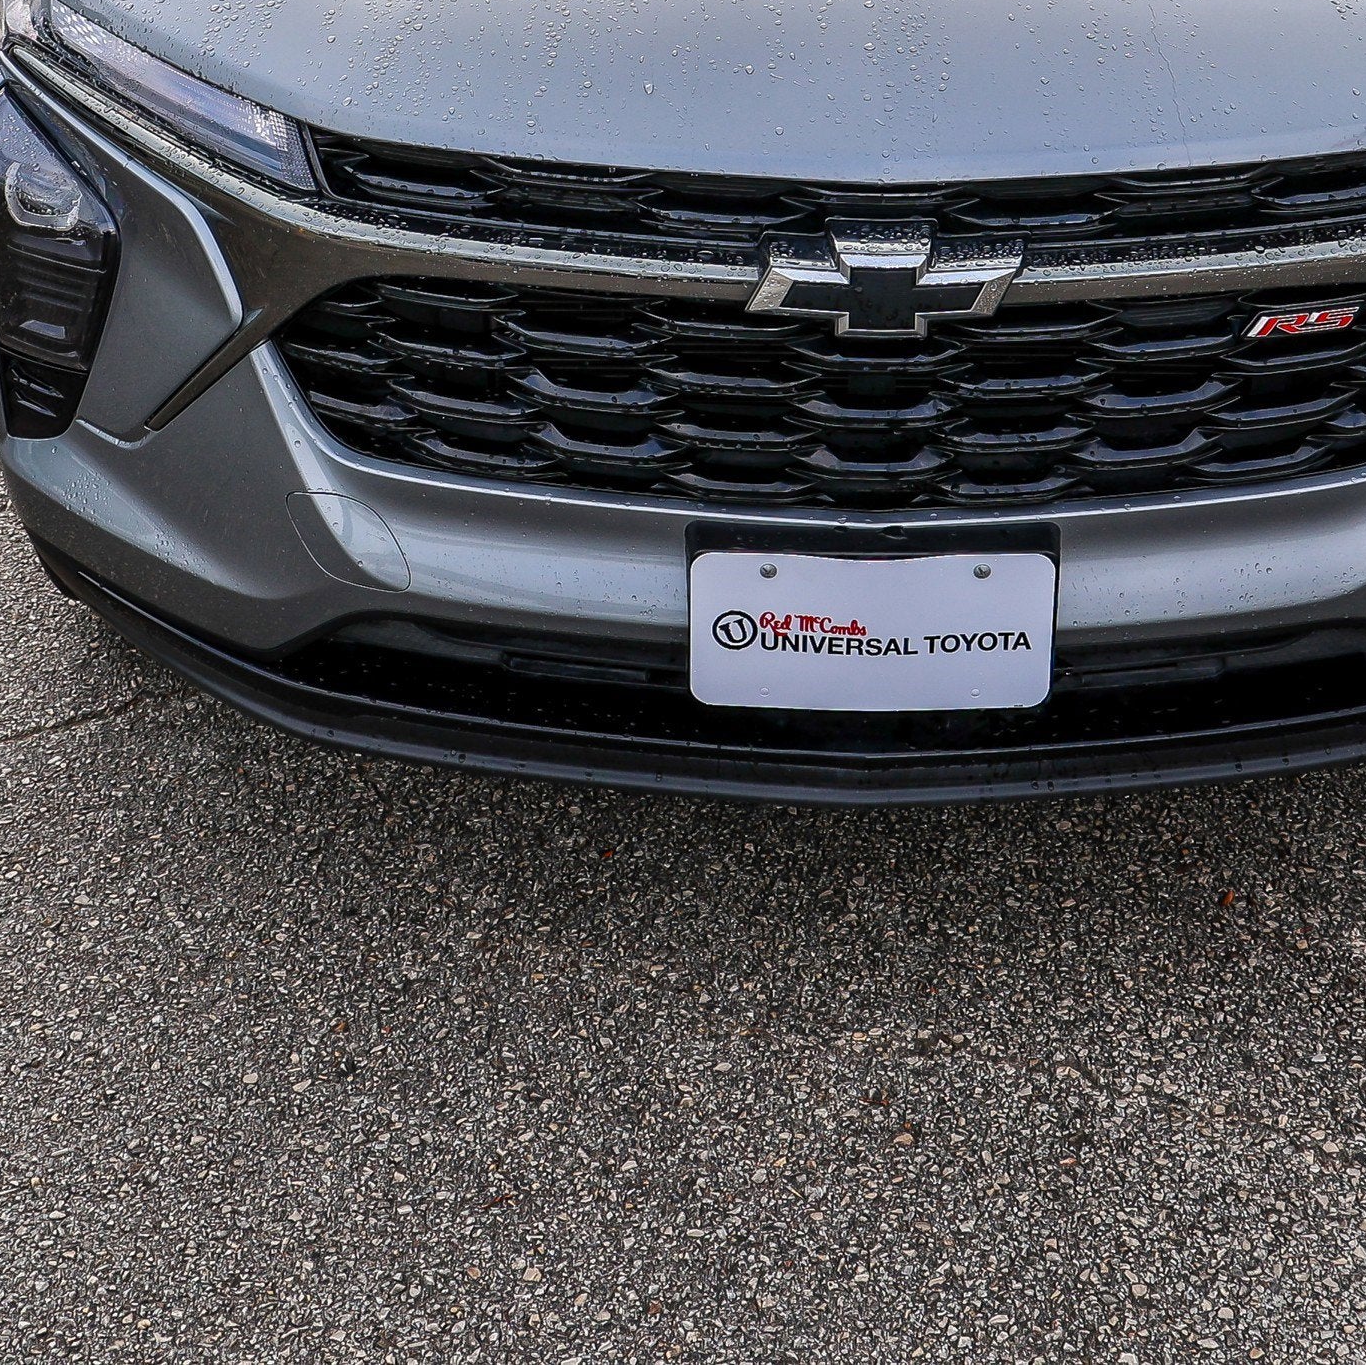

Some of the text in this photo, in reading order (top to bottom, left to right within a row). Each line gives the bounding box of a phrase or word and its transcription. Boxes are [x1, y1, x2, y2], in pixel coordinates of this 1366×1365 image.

[1246, 306, 1360, 338] RS
[759, 611, 867, 636] Red McCombs
[760, 631, 1032, 656] UNIVERSAL TOYOTA
